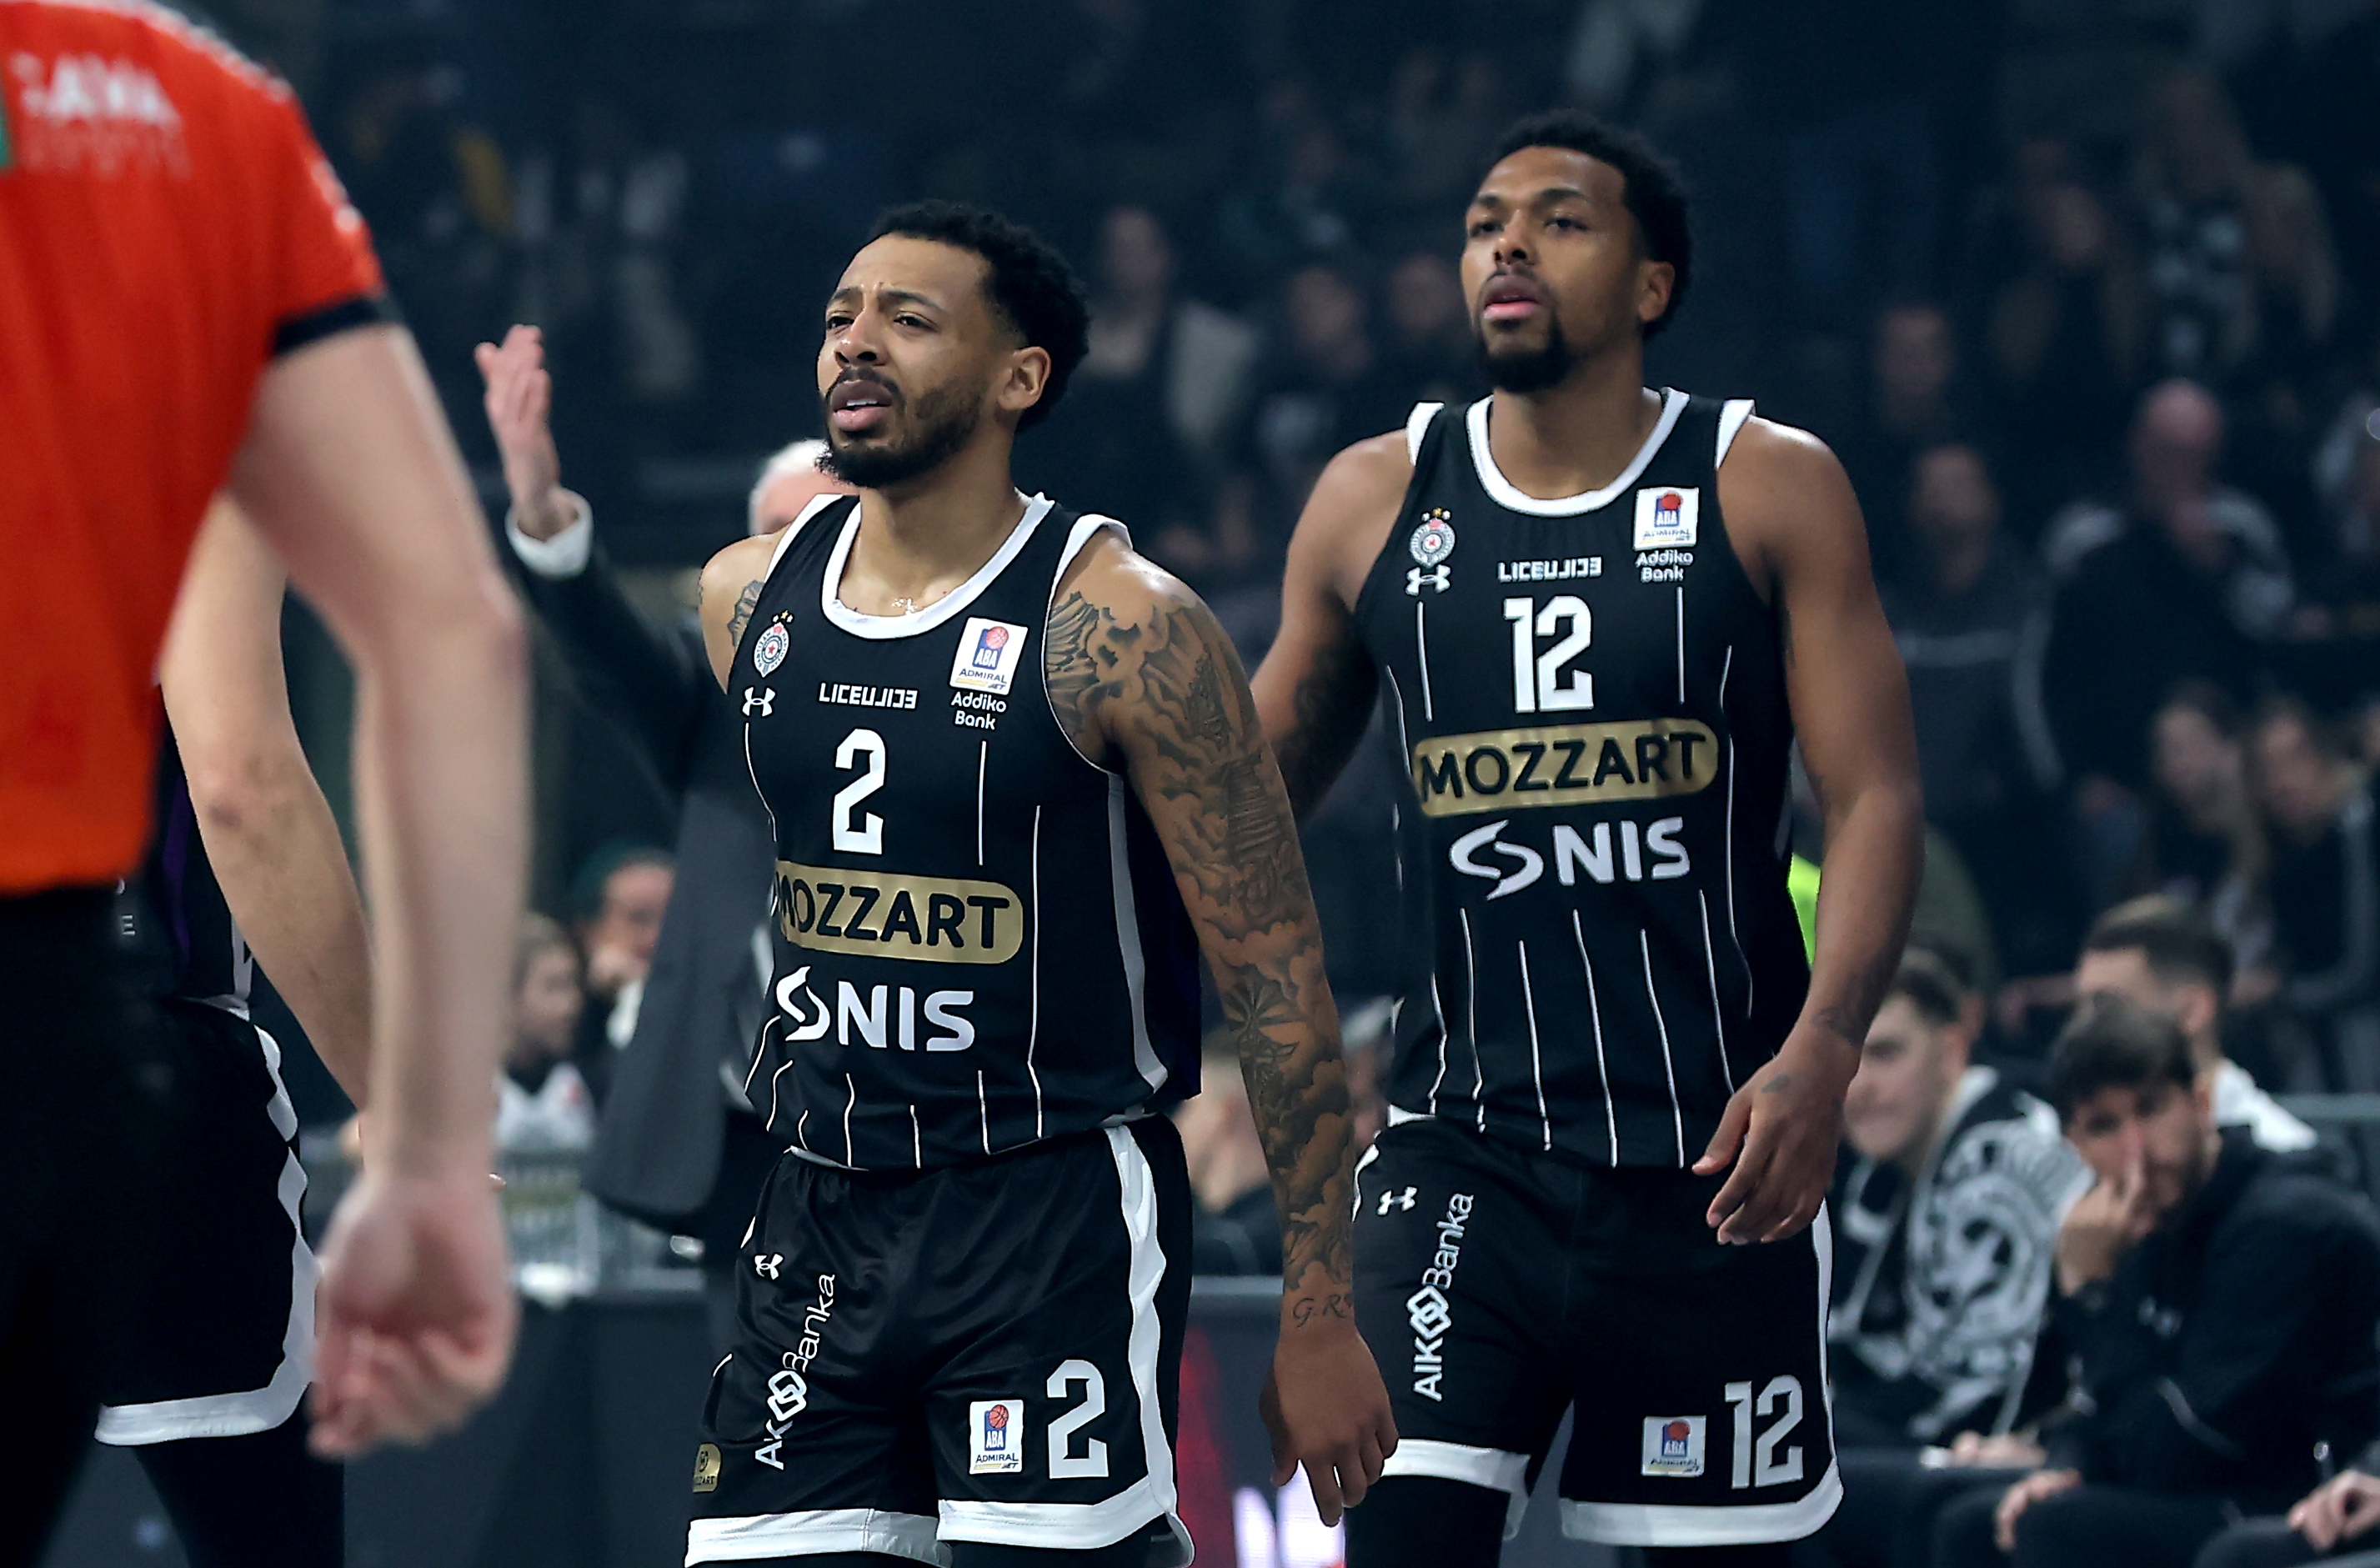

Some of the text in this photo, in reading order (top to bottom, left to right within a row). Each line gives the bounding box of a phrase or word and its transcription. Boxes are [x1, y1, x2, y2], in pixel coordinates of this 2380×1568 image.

[1635, 549, 1694, 568] Addiko
[1641, 564, 1684, 583] Bank
[959, 668, 1008, 684] ADMIRAL
[974, 648, 999, 668] ABA
[1503, 594, 1594, 714] 12
[950, 691, 1007, 713] Addiko
[955, 709, 996, 730] Bank
[1420, 731, 1706, 803] MOZZART
[833, 728, 885, 854] 2
[1551, 816, 1691, 886] NIS
[837, 980, 975, 1052] NIS
[1413, 1193, 1475, 1403] AIK Banka
[986, 1430, 1004, 1449] ABA
[1046, 1359, 1110, 1480] 2
[1725, 1375, 1803, 1490] 12
[975, 1452, 1020, 1464] ADMIRAL
